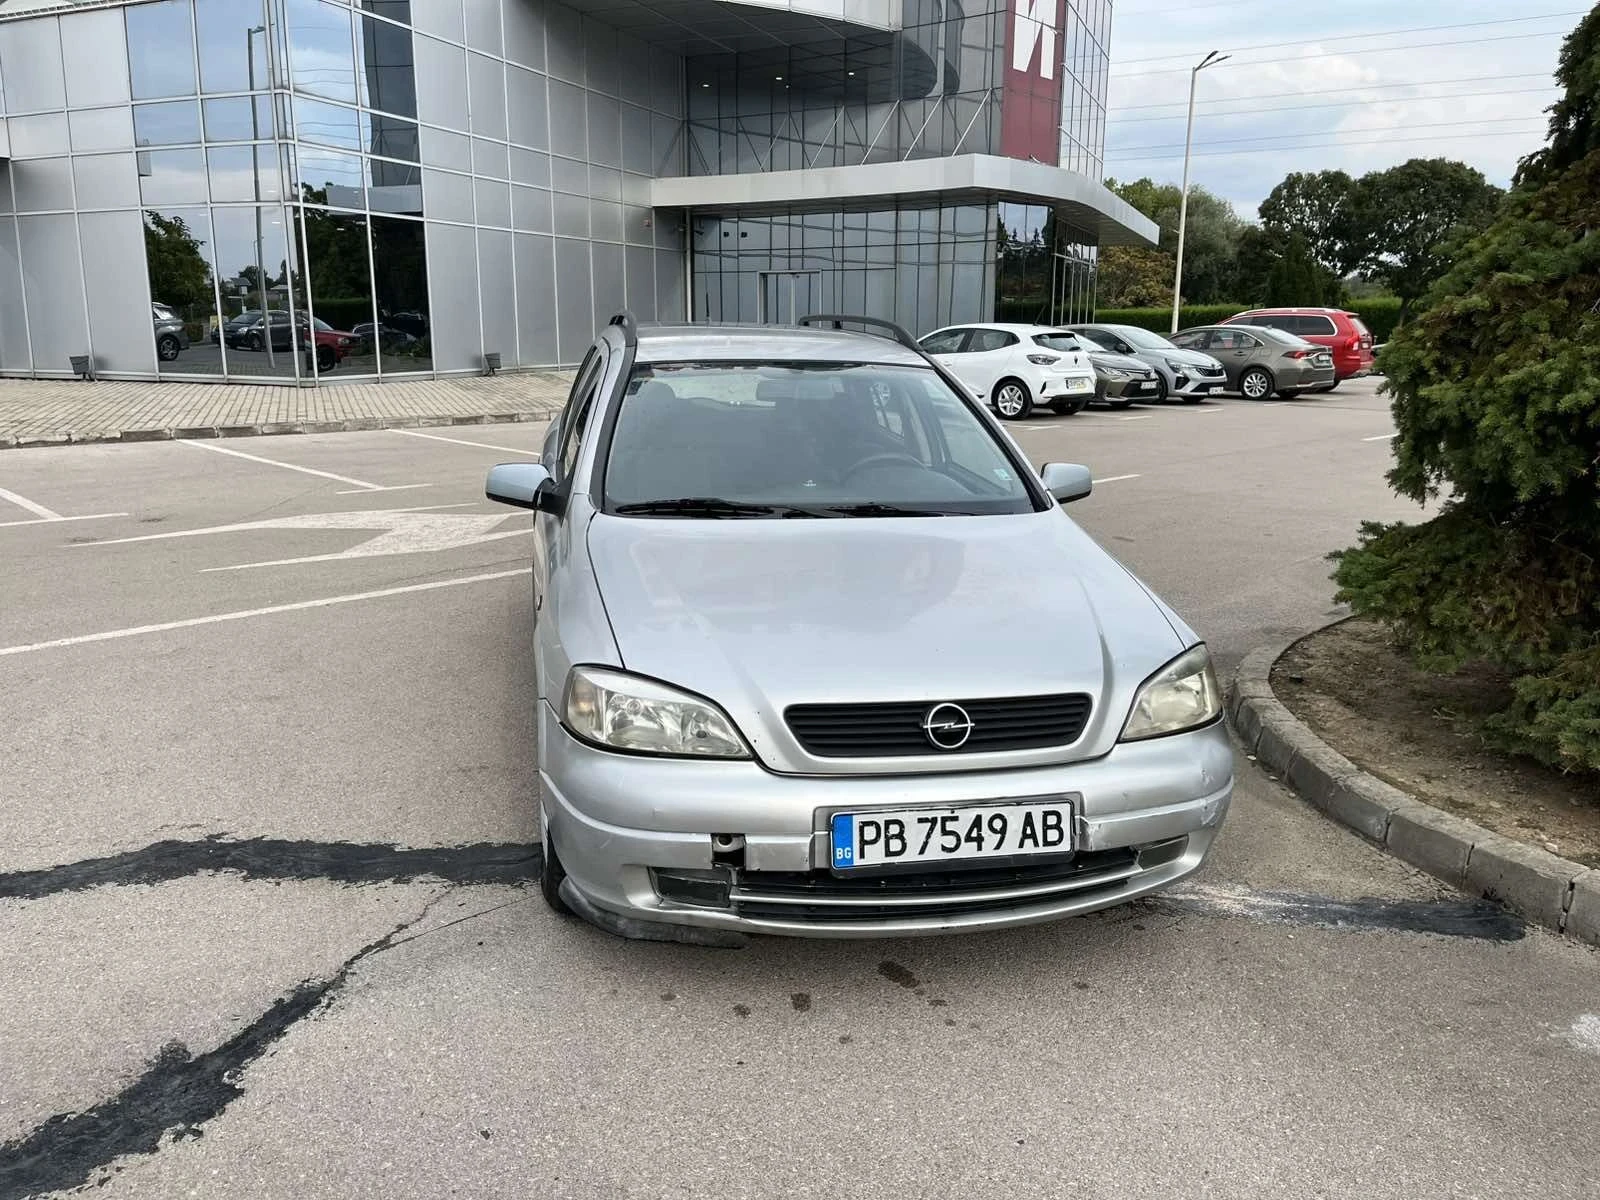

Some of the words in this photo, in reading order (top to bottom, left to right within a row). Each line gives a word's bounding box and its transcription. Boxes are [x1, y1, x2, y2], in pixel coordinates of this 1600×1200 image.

[859, 819, 907, 859] PB
[917, 813, 1008, 855] 7549
[1018, 810, 1064, 848] AB
[836, 847, 851, 859] BG
